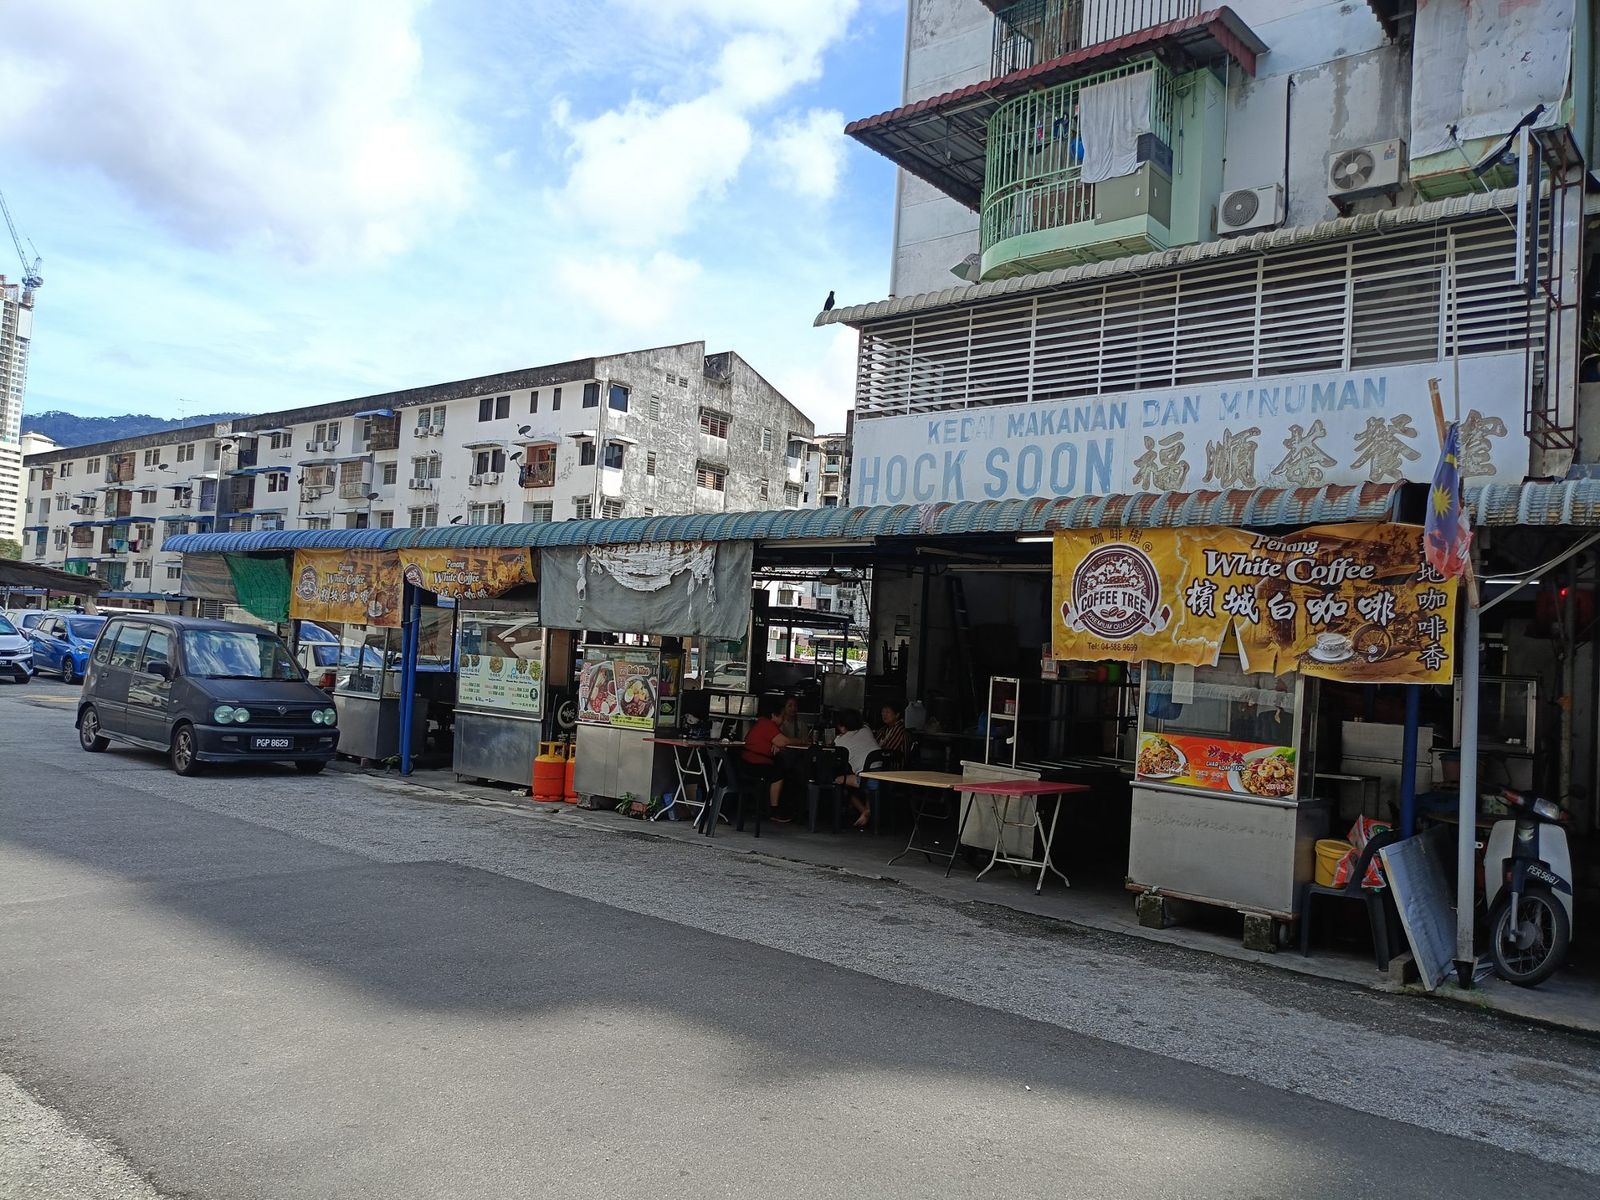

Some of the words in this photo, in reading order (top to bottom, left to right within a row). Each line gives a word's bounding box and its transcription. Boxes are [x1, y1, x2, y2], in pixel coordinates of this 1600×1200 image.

[928, 415, 994, 444] KEDAI
[1007, 402, 1127, 439] MAKANAN
[1142, 394, 1201, 428] DAN
[1218, 376, 1387, 421] MINUMAN
[858, 449, 968, 506] HOCK
[983, 438, 1115, 499] SOON
[1089, 528, 1143, 546] 咖啡樹
[1252, 535, 1319, 555] Penang
[433, 571, 457, 584] White
[457, 571, 480, 586] Coffee
[1204, 550, 1282, 578] White
[1285, 557, 1375, 586] Coffee
[1081, 590, 1118, 612] COFFEE
[1121, 590, 1147, 615] TREE
[1185, 578, 1398, 626] 檳城白咖啡
[1416, 536, 1450, 670] 地咖啡香
[1087, 612, 1113, 630] PREMIUM
[1113, 614, 1138, 630] QUALITY
[256, 739, 270, 747] PGP
[271, 739, 289, 748] 8629
